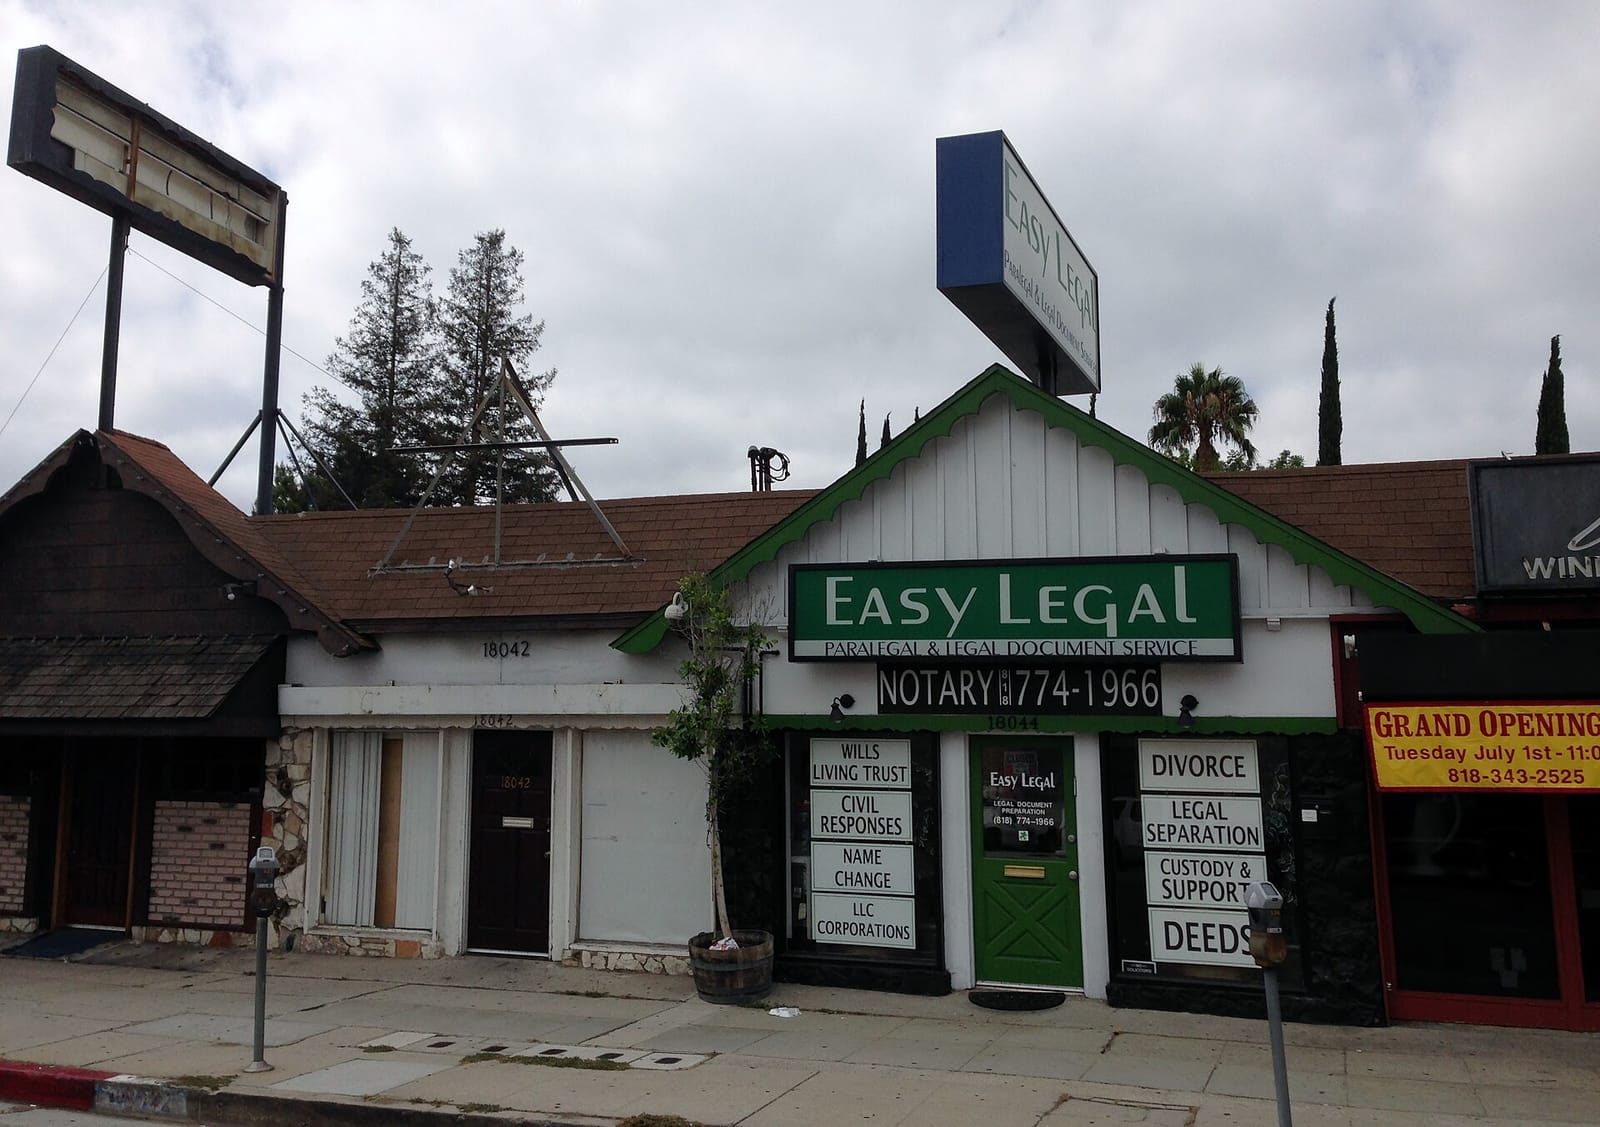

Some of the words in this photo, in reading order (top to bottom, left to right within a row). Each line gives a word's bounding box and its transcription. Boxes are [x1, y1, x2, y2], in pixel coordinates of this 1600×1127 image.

[483, 641, 530, 658] 18042
[825, 641, 921, 656] PARALEGAL
[928, 642, 940, 656] &
[946, 641, 1000, 656] LEGAL
[1008, 640, 1115, 656] DOCUMENT
[1123, 640, 1197, 656] SERVICE
[880, 669, 995, 706] NOTARY
[1016, 669, 1159, 707] 774-1966
[474, 714, 513, 727] 18042
[988, 715, 1039, 730] 18044
[1375, 711, 1471, 738] GRAND
[1479, 710, 1600, 737] OPENING
[842, 744, 880, 760] WILLS
[1384, 745, 1467, 763] Tuesday
[1474, 745, 1516, 763] July
[1523, 746, 1552, 760] 1st
[813, 764, 858, 781] LIVING
[863, 766, 907, 782] TRUST
[1152, 754, 1246, 778] DIVORCE
[501, 776, 531, 789] 18042
[1448, 768, 1584, 784] 818-343-2525
[842, 795, 879, 814] CIVIL
[1172, 801, 1228, 820] LEGAL
[821, 816, 902, 835] RESPONSES
[994, 817, 1012, 825] (818)
[1017, 817, 1054, 826] 774-1966
[1147, 824, 1259, 846] SEPARATION
[844, 849, 882, 865] NAME
[1160, 859, 1234, 878] CUSTODY
[1240, 862, 1251, 878] &
[835, 871, 891, 889] CHANGE
[854, 903, 874, 917] LLC
[818, 920, 910, 940] CORPORATIONS
